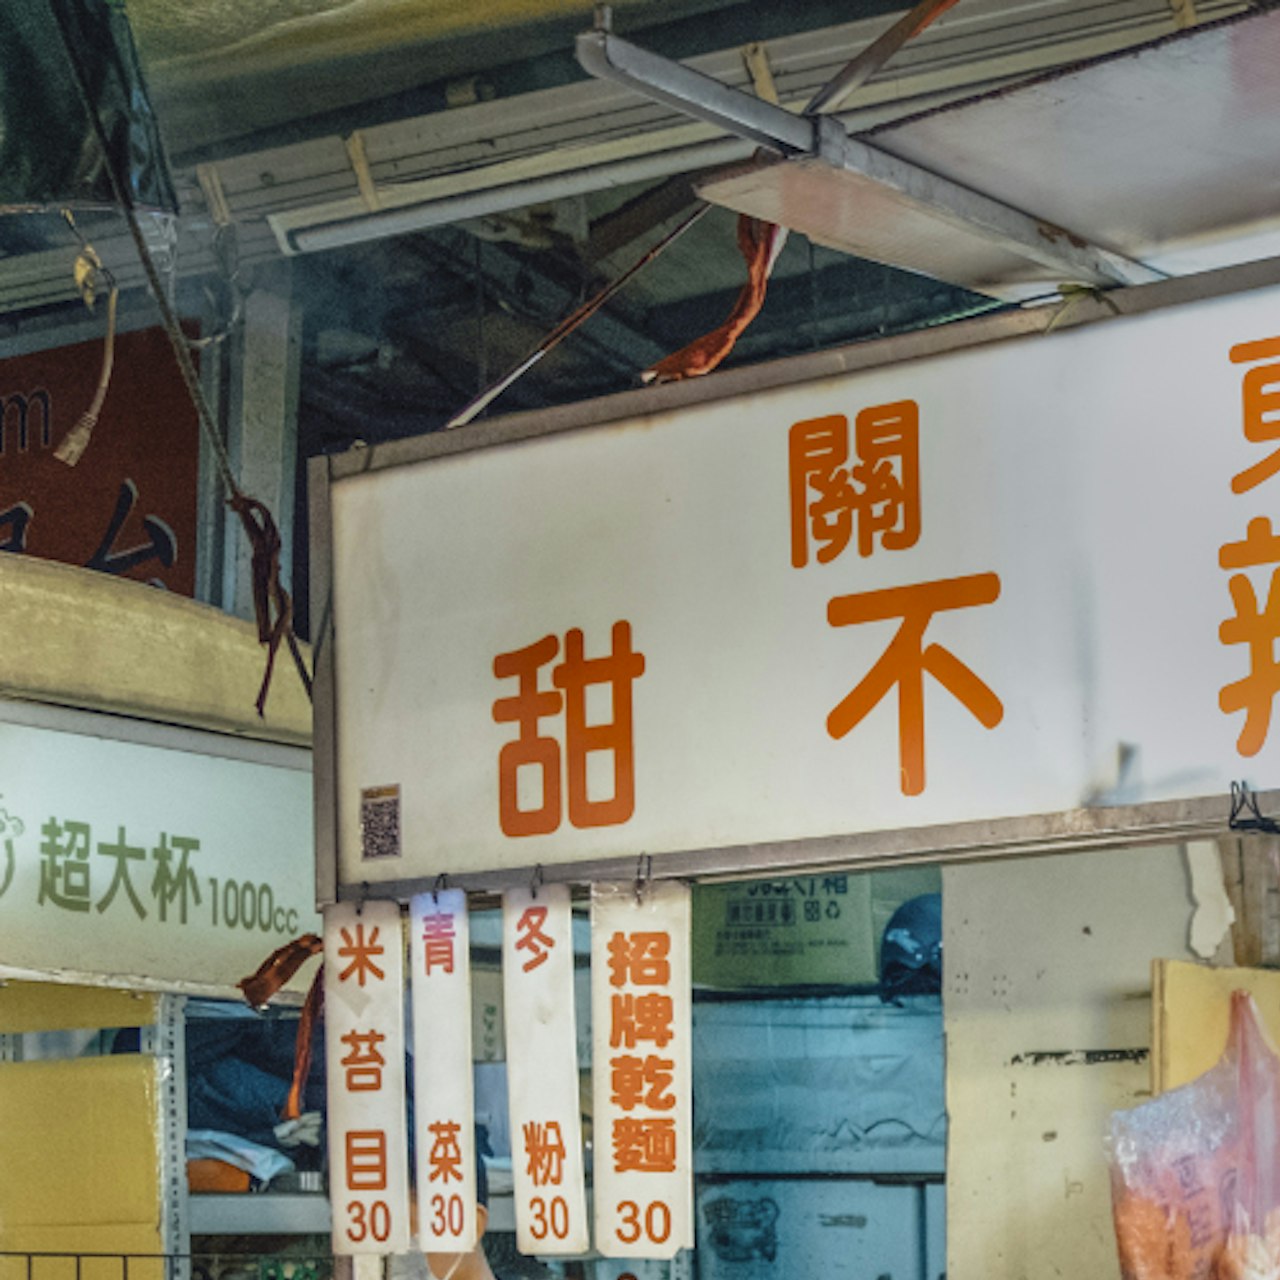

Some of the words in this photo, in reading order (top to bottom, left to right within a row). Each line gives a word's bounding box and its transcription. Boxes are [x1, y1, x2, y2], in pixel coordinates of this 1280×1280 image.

[38, 816, 202, 925] 超大杯
[208, 877, 299, 935] 1000cc
[338, 923, 386, 1190] 米苔目
[422, 912, 463, 1184] 青菜
[515, 906, 566, 1187] 冬粉
[607, 931, 676, 1173] 招牌乾麵
[346, 1200, 391, 1243] 30
[430, 1194, 464, 1237] 30
[529, 1196, 569, 1240] 30
[615, 1200, 671, 1244] 30
